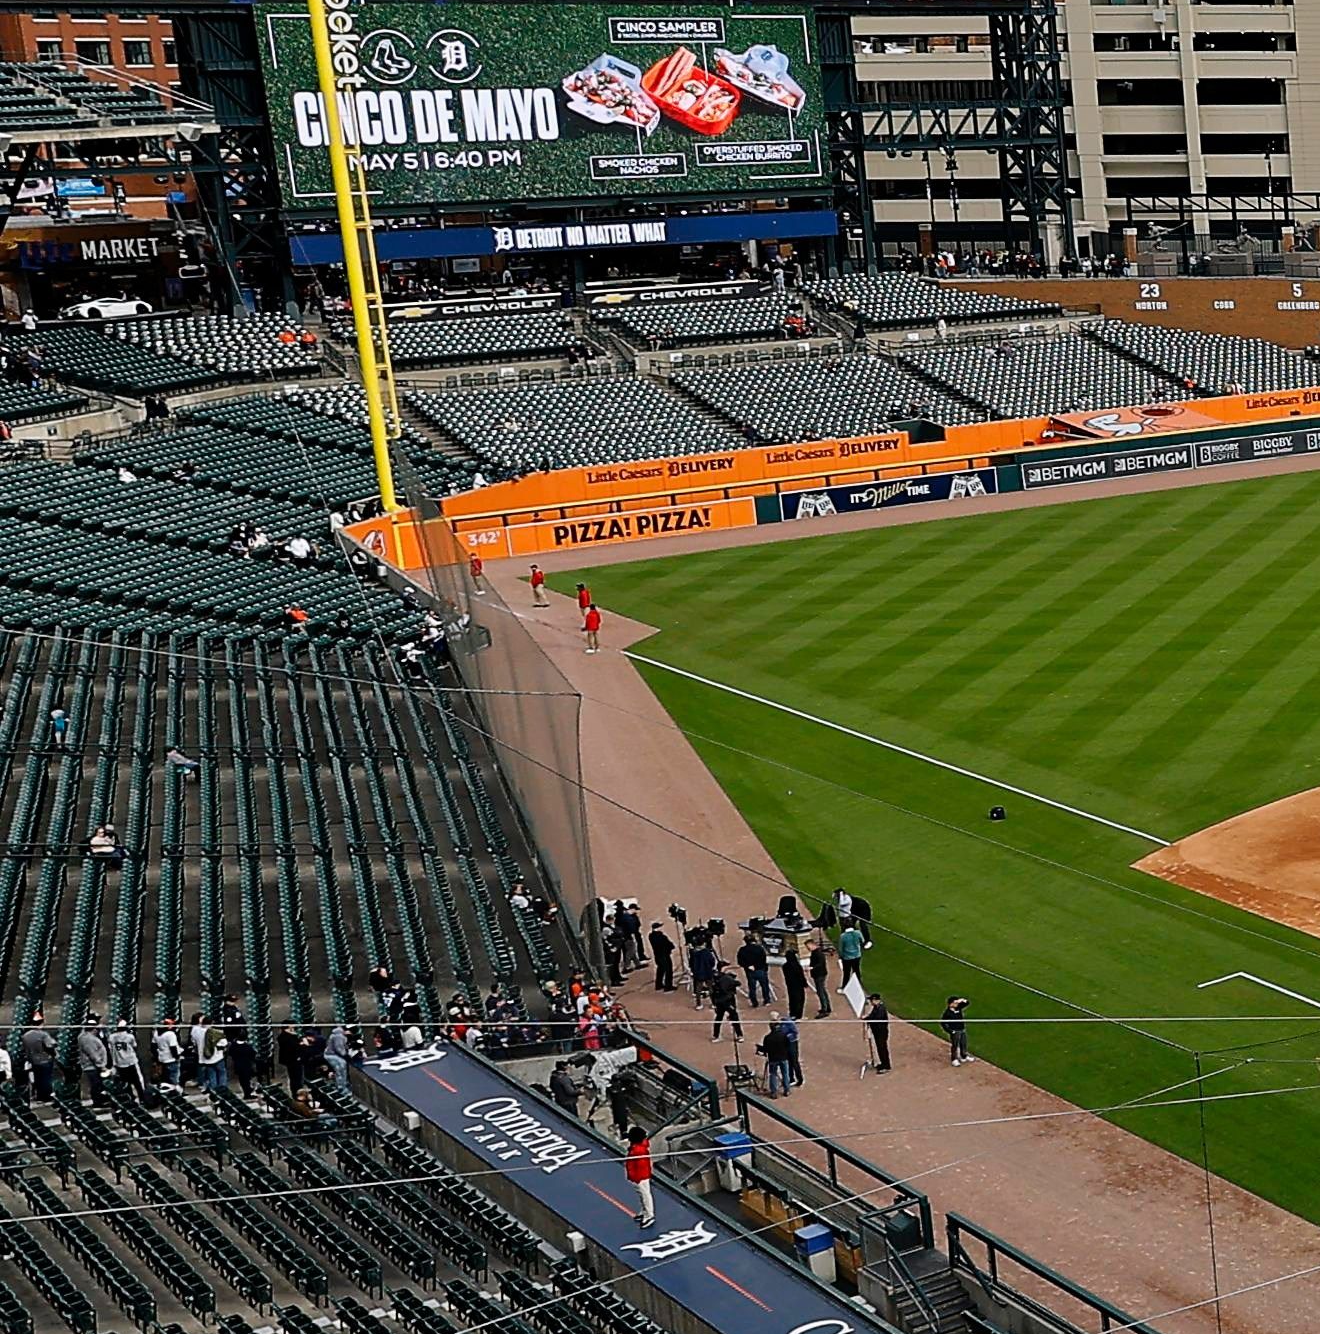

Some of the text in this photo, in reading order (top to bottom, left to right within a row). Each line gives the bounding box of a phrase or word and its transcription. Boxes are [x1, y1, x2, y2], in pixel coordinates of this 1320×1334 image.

[617, 22, 717, 33] CINCO SAMPLER
[439, 38, 469, 73] D
[414, 88, 560, 144] DE MAYO
[703, 145, 765, 155] OVERSTUFFED
[755, 152, 793, 160] BURRITO
[350, 149, 522, 171] MAY 5 6:40 PM
[598, 157, 678, 167] SMOKED CHICKEN
[515, 222, 666, 249] DETROIT NO MATTER WHAT
[80, 237, 159, 260] MARKET
[640, 285, 743, 301] CHEVROLET
[1140, 283, 1160, 297] 23
[1292, 283, 1302, 297] 5
[441, 298, 556, 315] CHEVROLET
[1136, 301, 1167, 310] HORTON
[1213, 301, 1235, 309] COBB
[1268, 396, 1300, 408] Caesars
[794, 438, 900, 460] Caesars DELIVERY
[1252, 435, 1295, 451] BIGGBY
[1126, 451, 1188, 472] BETMGM
[586, 457, 736, 484] Little Caesars DELIVERY
[1043, 460, 1106, 481] BETMGM
[870, 480, 930, 507] Miller TIME
[553, 508, 712, 546] PIZZA! PIZZA!
[467, 531, 500, 547] 342'
[464, 1122, 526, 1163] PARK
